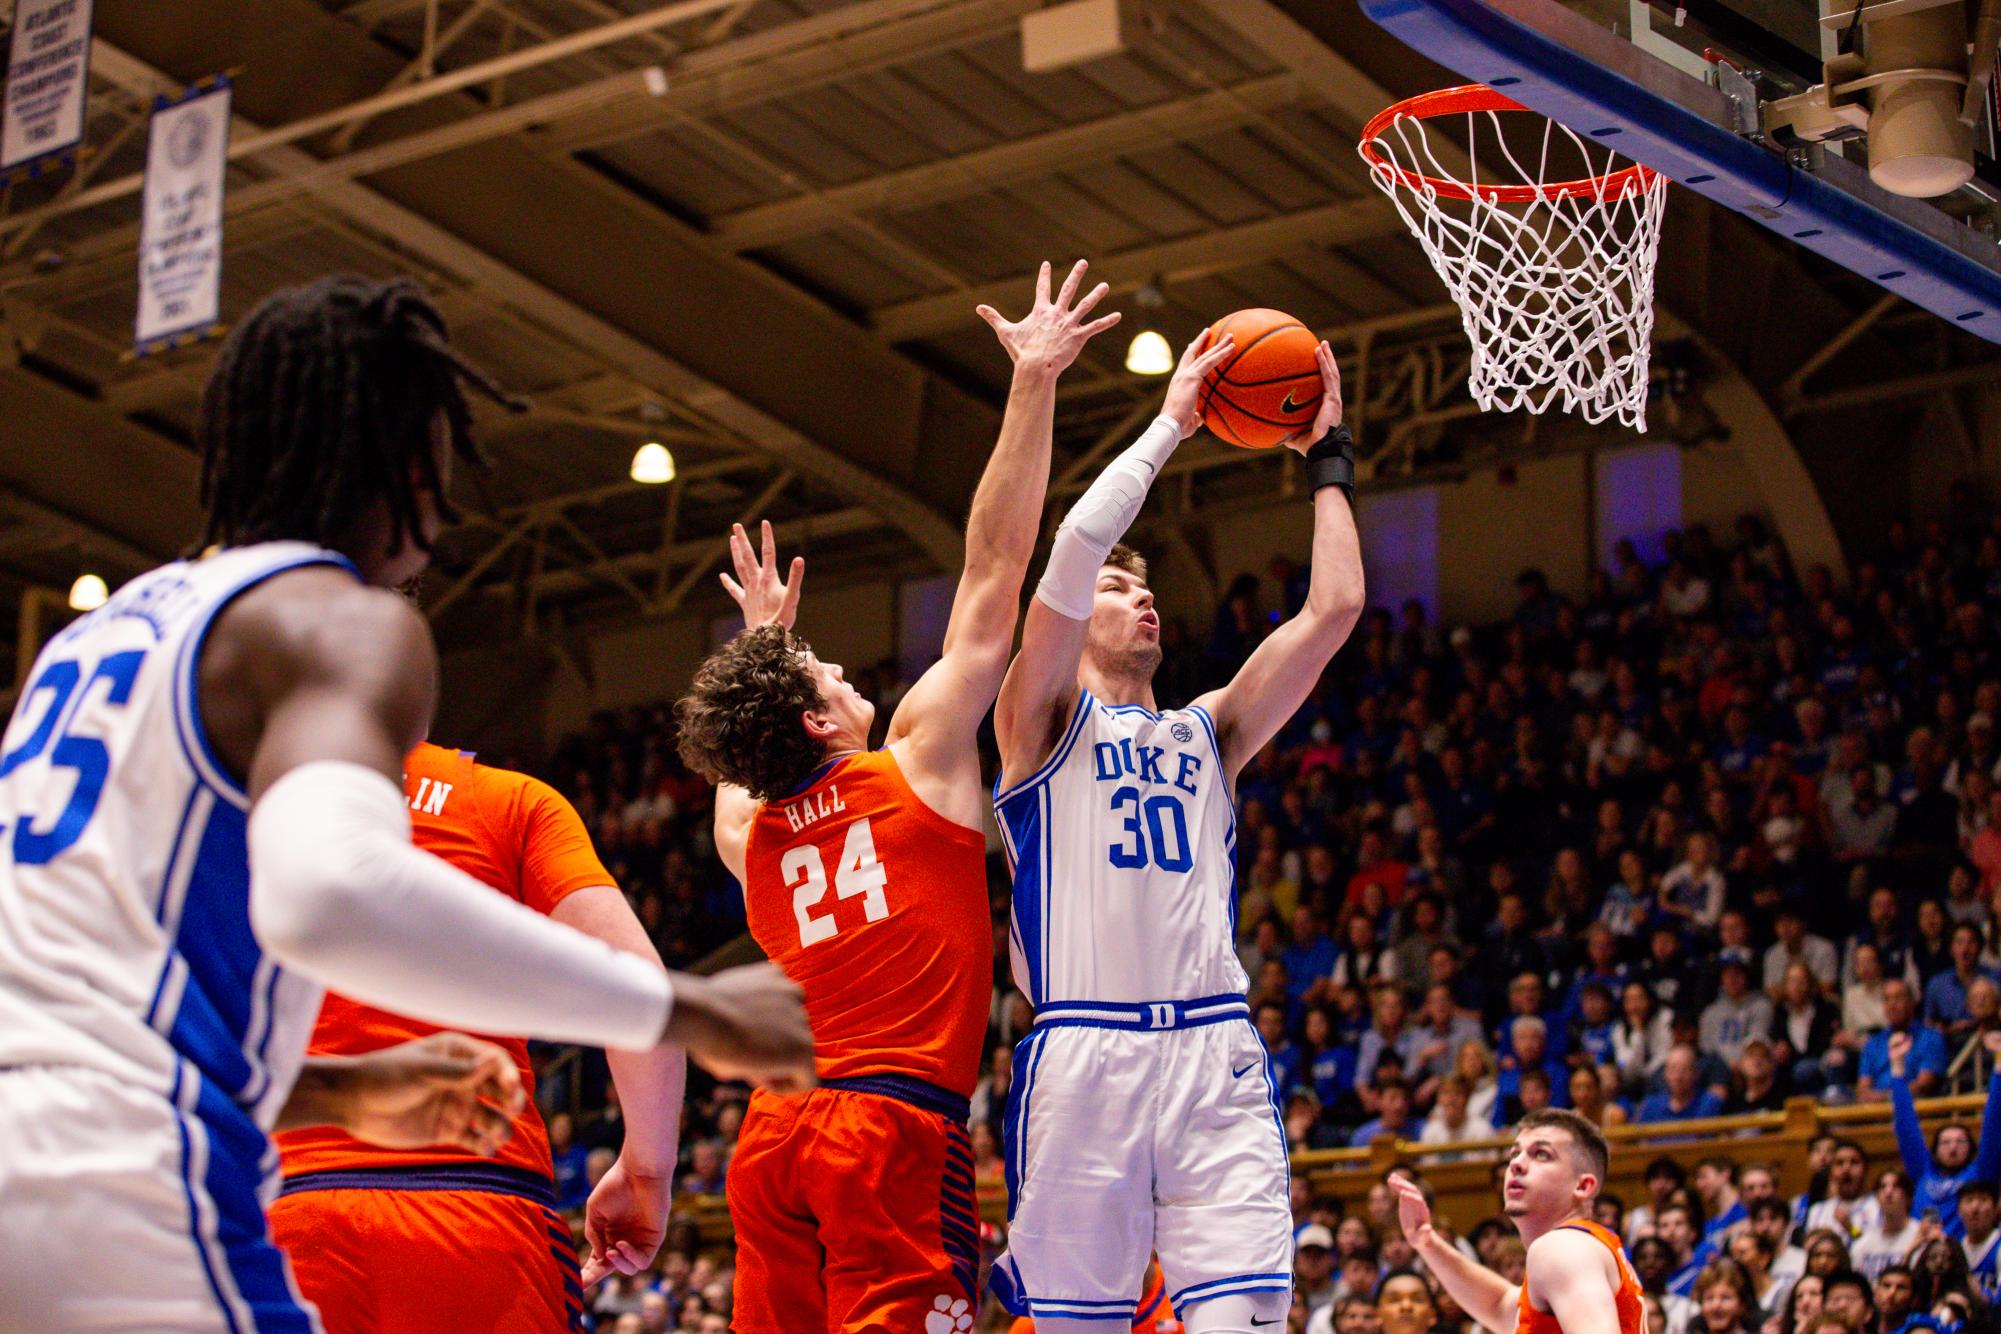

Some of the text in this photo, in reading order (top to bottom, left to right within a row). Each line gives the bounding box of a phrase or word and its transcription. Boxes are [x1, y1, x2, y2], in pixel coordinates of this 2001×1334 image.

[0, 649, 148, 864] 25
[1094, 738, 1201, 797] DUKE
[403, 774, 453, 816] IN
[784, 784, 846, 833] HALL
[1109, 786, 1193, 873] 30
[780, 817, 890, 949] 24
